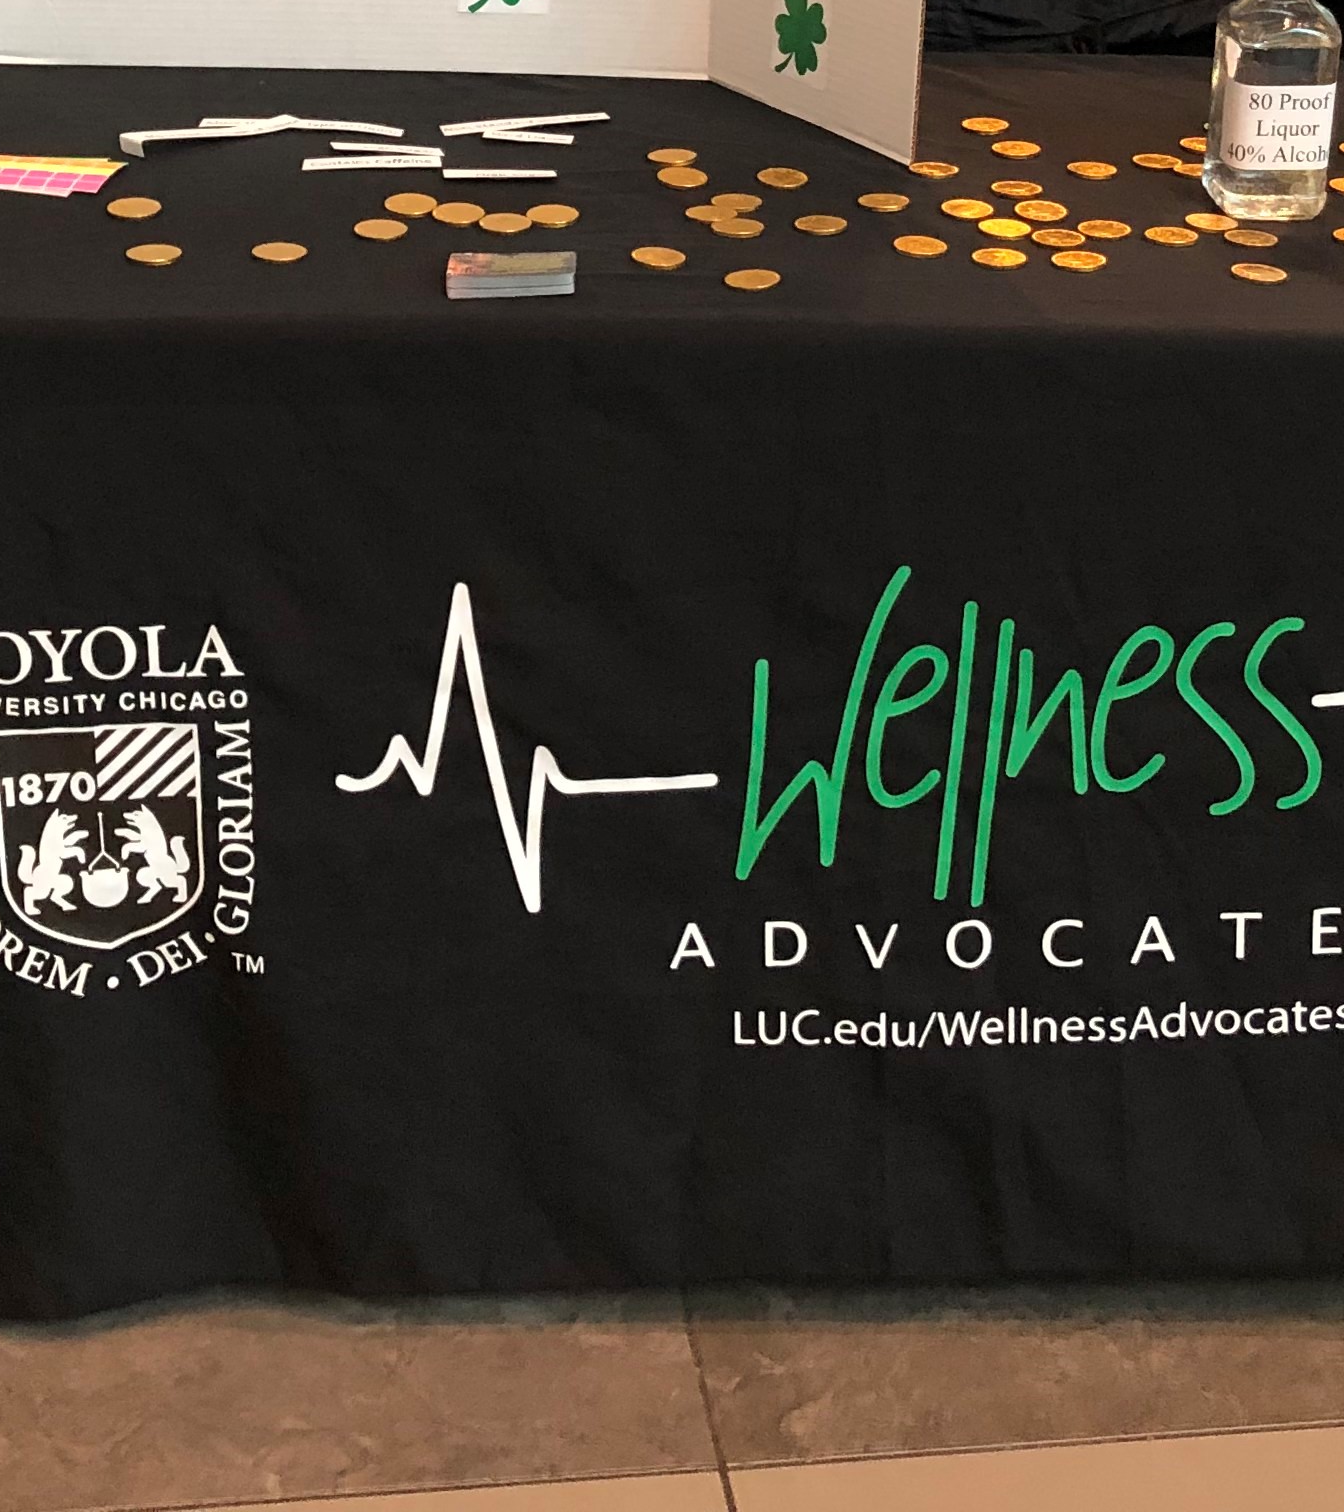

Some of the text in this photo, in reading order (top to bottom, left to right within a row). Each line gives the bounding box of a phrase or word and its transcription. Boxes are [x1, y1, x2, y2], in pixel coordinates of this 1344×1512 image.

[1248, 92, 1334, 111] 80 Proof
[1256, 119, 1321, 142] Liquor
[1227, 142, 1267, 164] 40%
[118, 689, 250, 713] CHICAGO
[732, 565, 1323, 908] Wellness
[0, 771, 97, 808] 1870
[126, 931, 209, 988] DEI
[213, 718, 257, 936] GLORIAM
